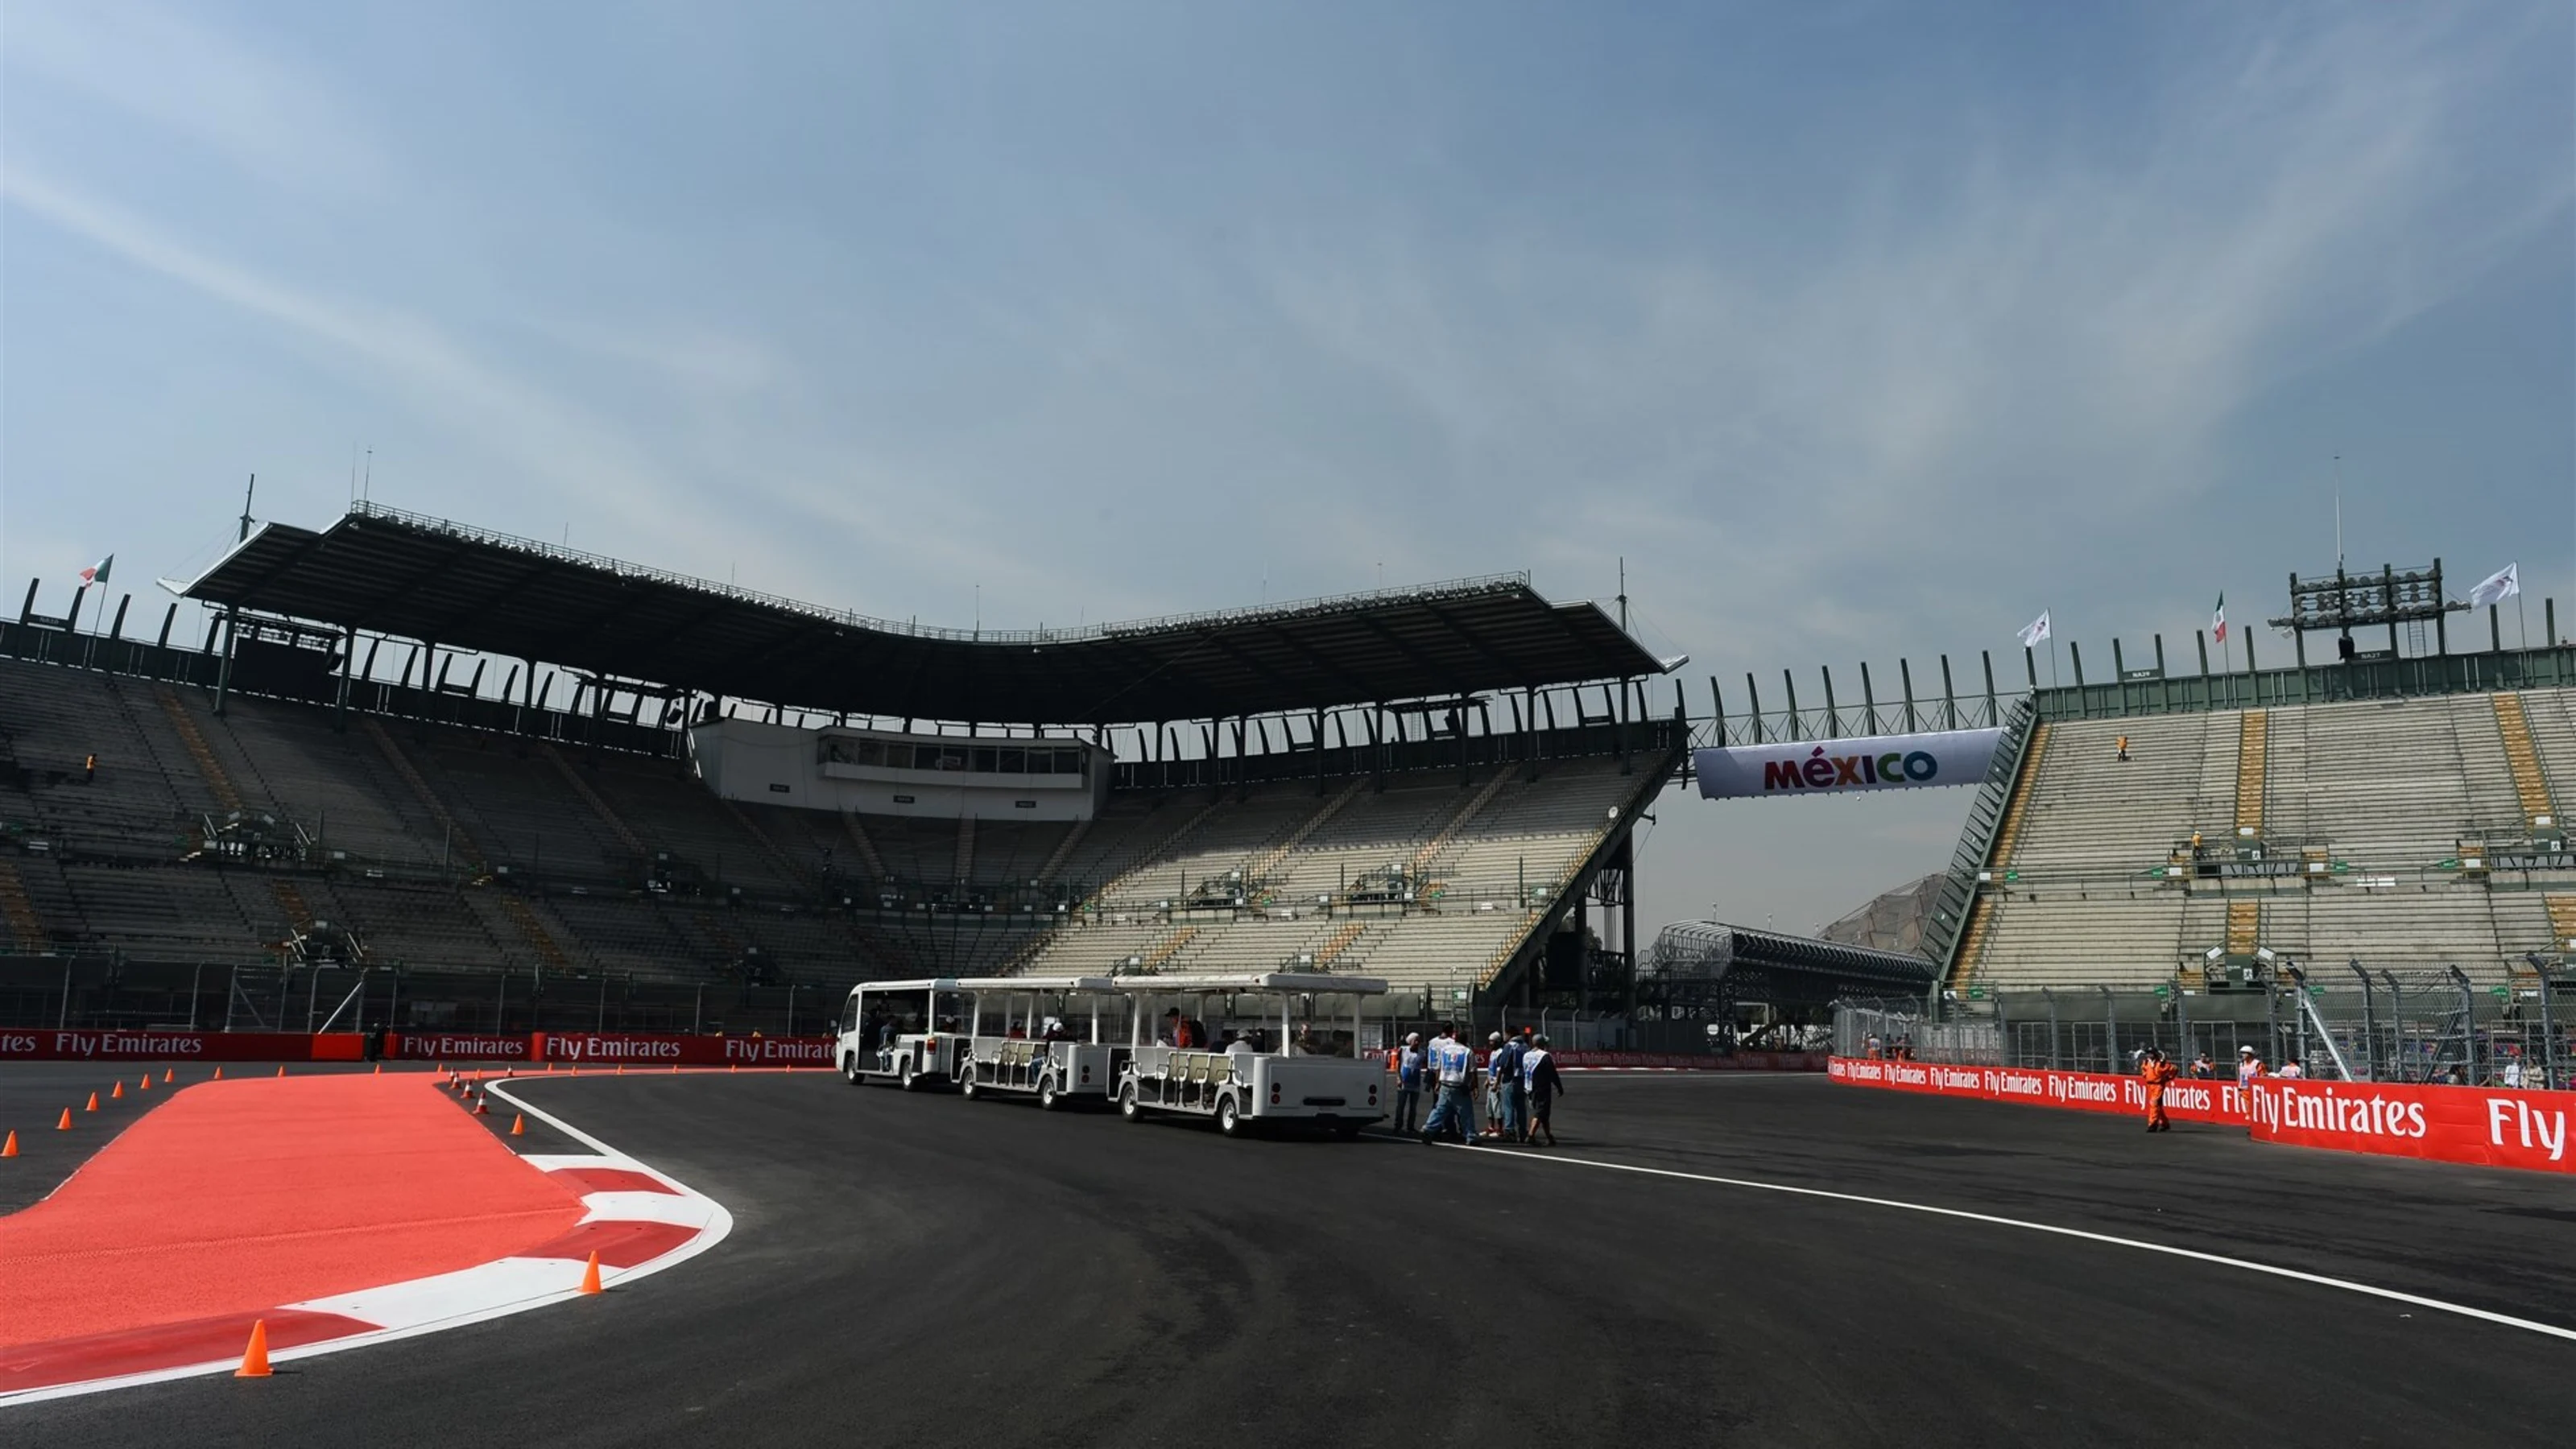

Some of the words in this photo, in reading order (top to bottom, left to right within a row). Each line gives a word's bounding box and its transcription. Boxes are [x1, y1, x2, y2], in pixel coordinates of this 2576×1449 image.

[56, 1033, 97, 1056] Fly
[101, 1034, 202, 1053] Emirates
[404, 1037, 436, 1057] Fly
[440, 1037, 523, 1055] Emirates
[547, 1037, 582, 1060] Fly
[586, 1037, 680, 1057] Emirates
[726, 1039, 759, 1062] Fly
[1856, 1062, 1881, 1080] Emirates
[1884, 1063, 1896, 1085] Fly
[1896, 1064, 1926, 1084] Emirates
[1930, 1067, 1943, 1090] Fly
[1944, 1067, 1980, 1089] Emirates
[1984, 1071, 1999, 1096] Fly
[2000, 1071, 2042, 1095] Emirates
[2048, 1075, 2066, 1103] Fly
[2068, 1075, 2116, 1102] Emirates
[2124, 1080, 2146, 1111] Fly
[2252, 1084, 2279, 1133] Fly
[2282, 1087, 2426, 1137] Emirates
[2487, 1098, 2566, 1161] Fly
